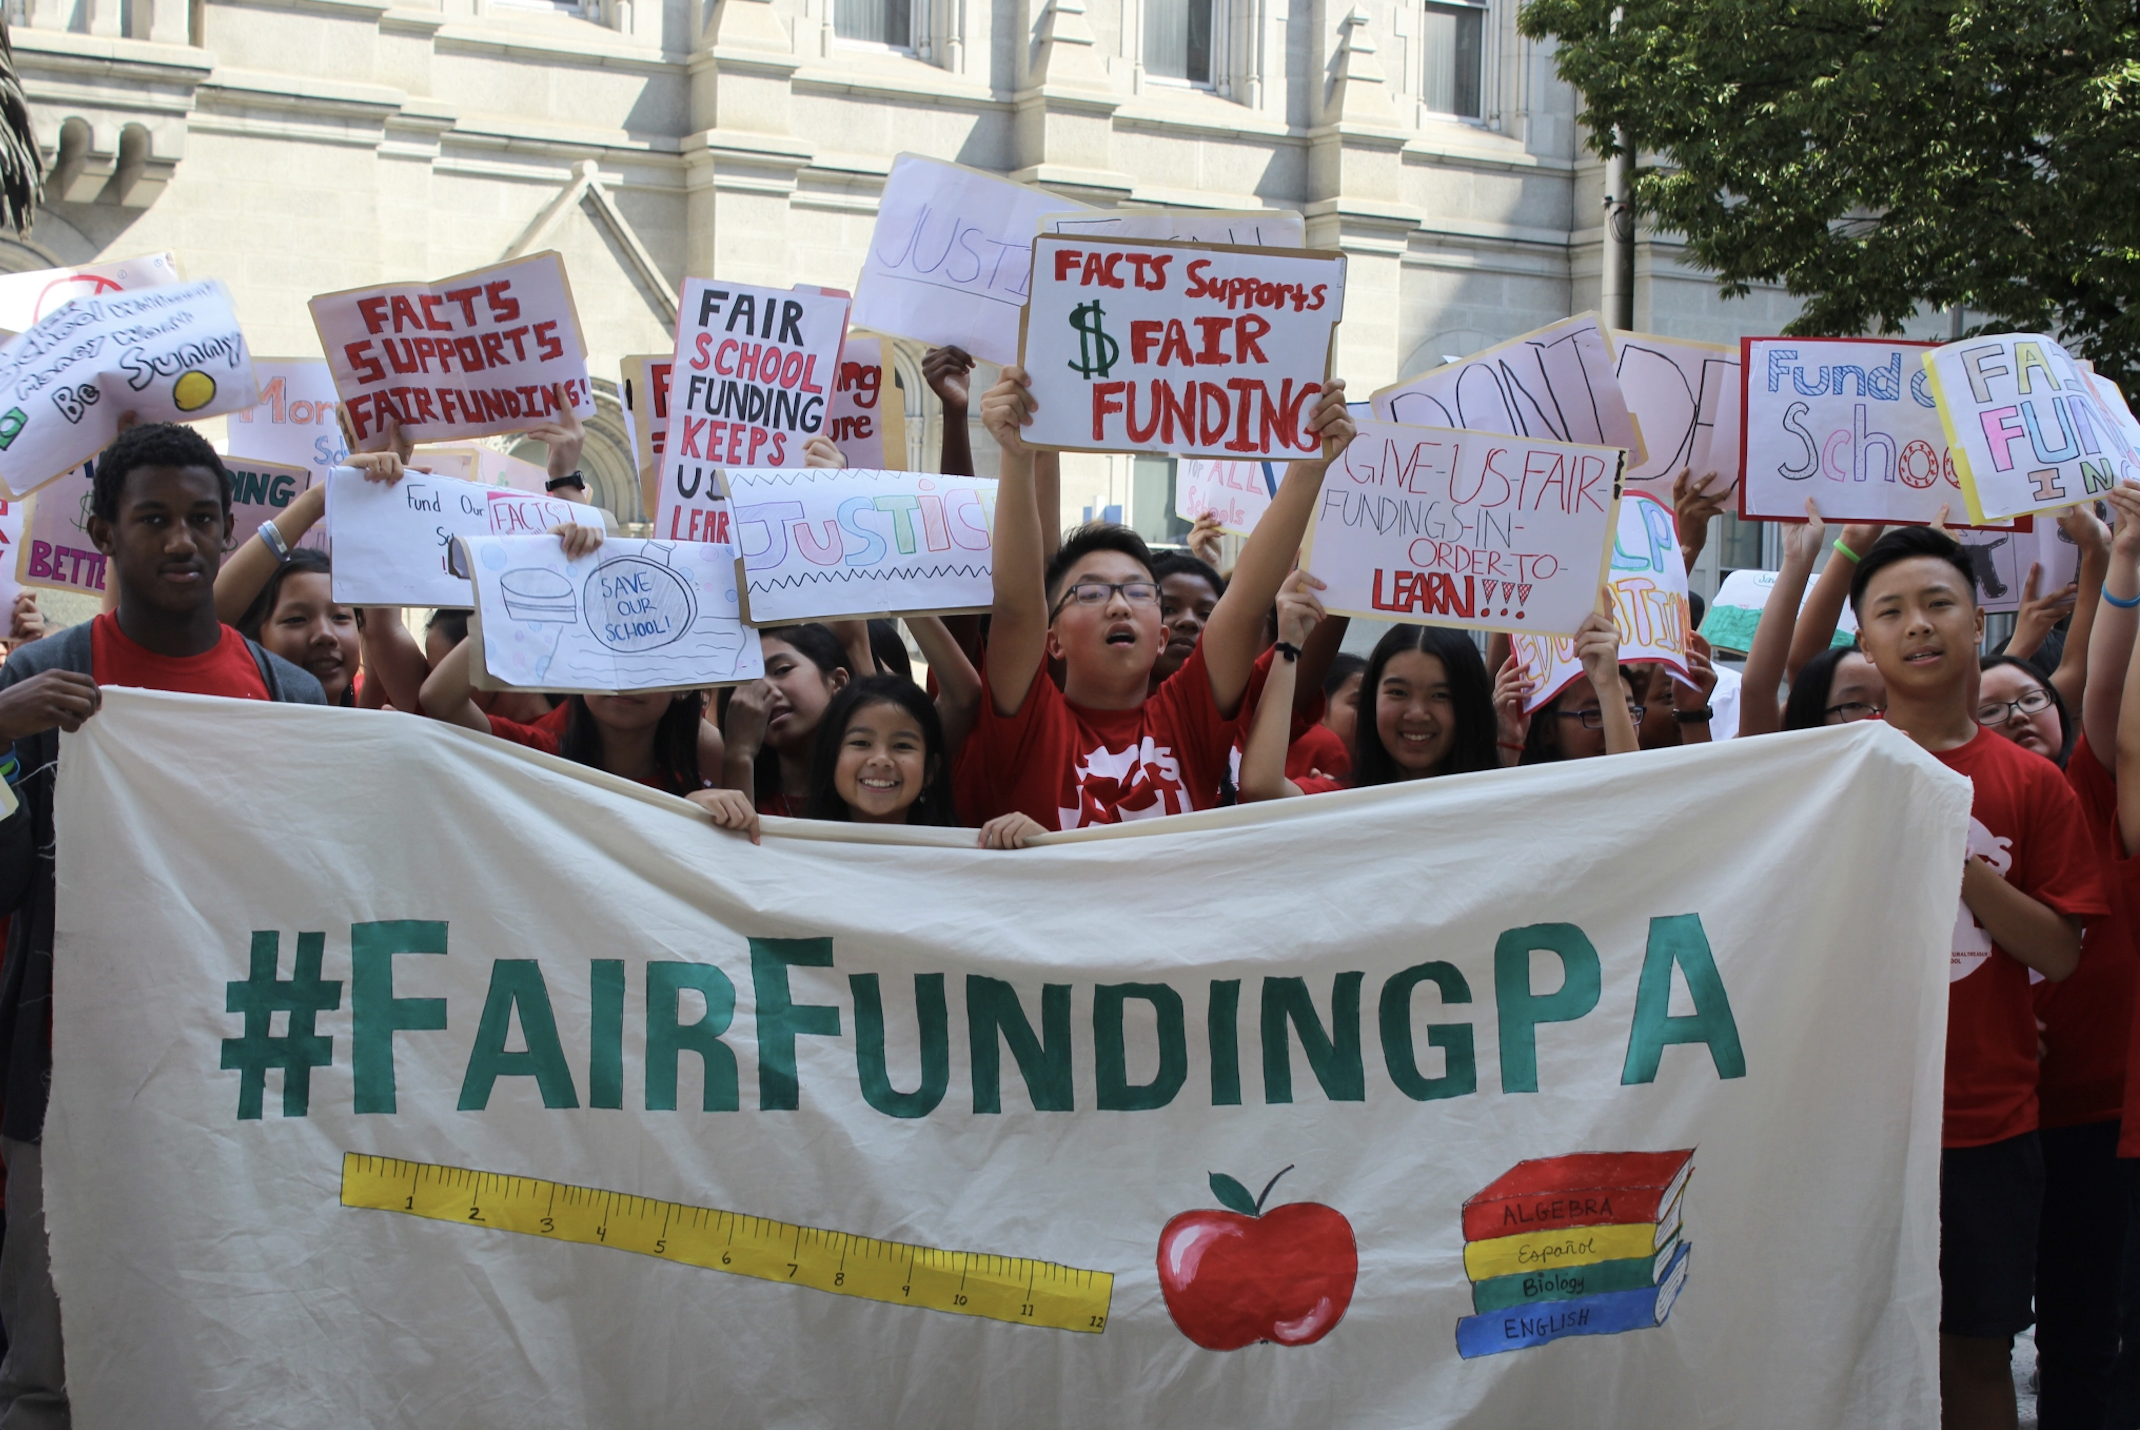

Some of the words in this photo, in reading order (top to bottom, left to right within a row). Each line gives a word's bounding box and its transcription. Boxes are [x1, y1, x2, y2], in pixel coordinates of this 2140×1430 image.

[1055, 250, 1173, 291] FACTS
[357, 280, 520, 334] FACTS
[698, 289, 804, 346] FAIR
[344, 320, 563, 384] SUPPORTS
[689, 332, 823, 394] SCHOOL
[1068, 299, 1119, 379] $
[1131, 314, 1270, 367] FAIR
[52, 384, 100, 424] Be
[119, 331, 242, 391] Sunny
[239, 376, 341, 425] Mor
[1768, 350, 1901, 401] Fund
[345, 387, 440, 441] FAIR
[687, 375, 824, 433] FUNDING
[1092, 378, 1322, 453] FUNDING
[680, 415, 787, 466] KEEPS
[406, 484, 441, 512] Fund
[460, 494, 485, 517] Our
[1207, 459, 1263, 495] ALL
[670, 505, 730, 544] LEAR
[601, 572, 651, 598] SAVE
[618, 598, 657, 616] OUR
[605, 615, 671, 641] SCHOOL!
[1504, 1197, 1613, 1226] ALGEBRA
[405, 1196, 414, 1210] 1
[469, 1207, 485, 1222] 2
[540, 1218, 554, 1233] 3
[596, 1226, 607, 1242] 4
[654, 1240, 667, 1254] 5
[721, 1251, 732, 1266] 6
[786, 1263, 798, 1278] 7
[834, 1272, 844, 1287] 8
[902, 1285, 910, 1298] 9
[953, 1294, 968, 1307] 10
[1020, 1304, 1034, 1318] 11
[1089, 1315, 1104, 1329] 12
[1518, 1237, 1596, 1264] Español
[1523, 1272, 1584, 1297] Biology
[1504, 1308, 1590, 1339] ENGLISH
